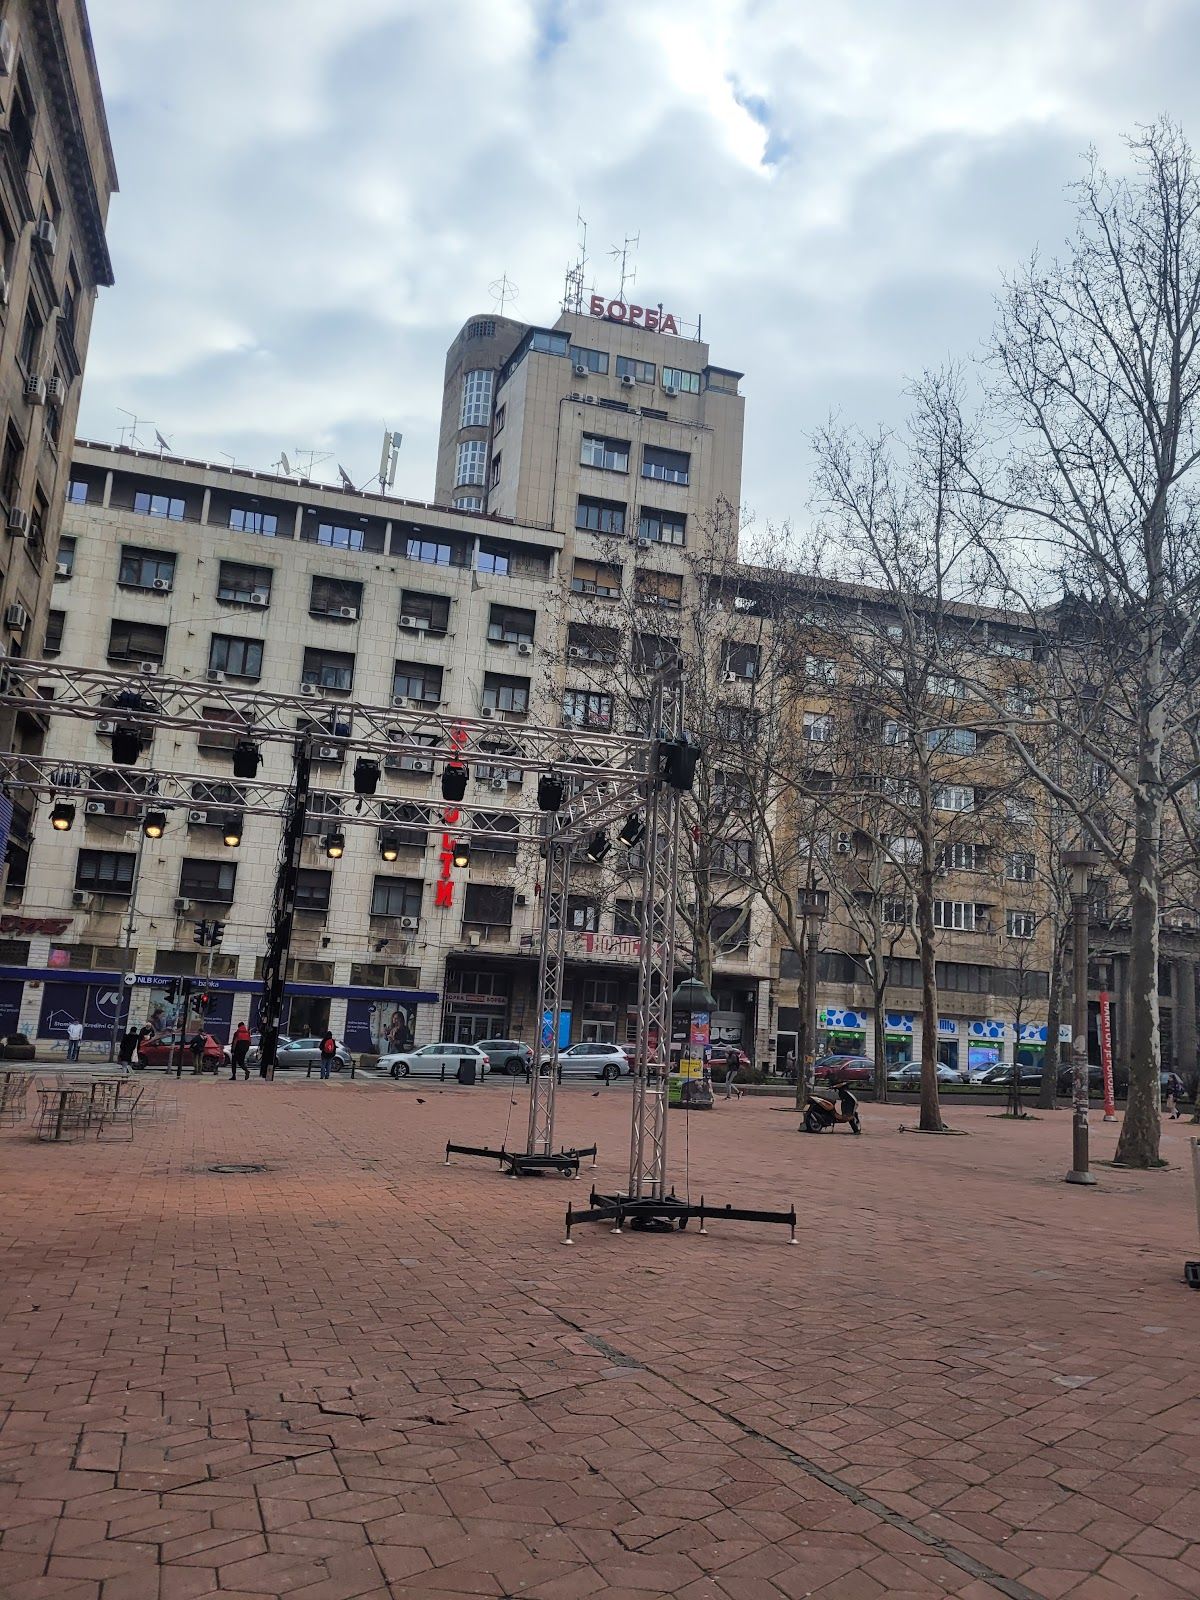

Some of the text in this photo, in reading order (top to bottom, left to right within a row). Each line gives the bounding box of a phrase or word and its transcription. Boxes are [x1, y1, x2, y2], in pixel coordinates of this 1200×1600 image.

[590, 295, 678, 335] БОРБА
[137, 976, 152, 984] NLB
[939, 1019, 956, 1033] lilly
